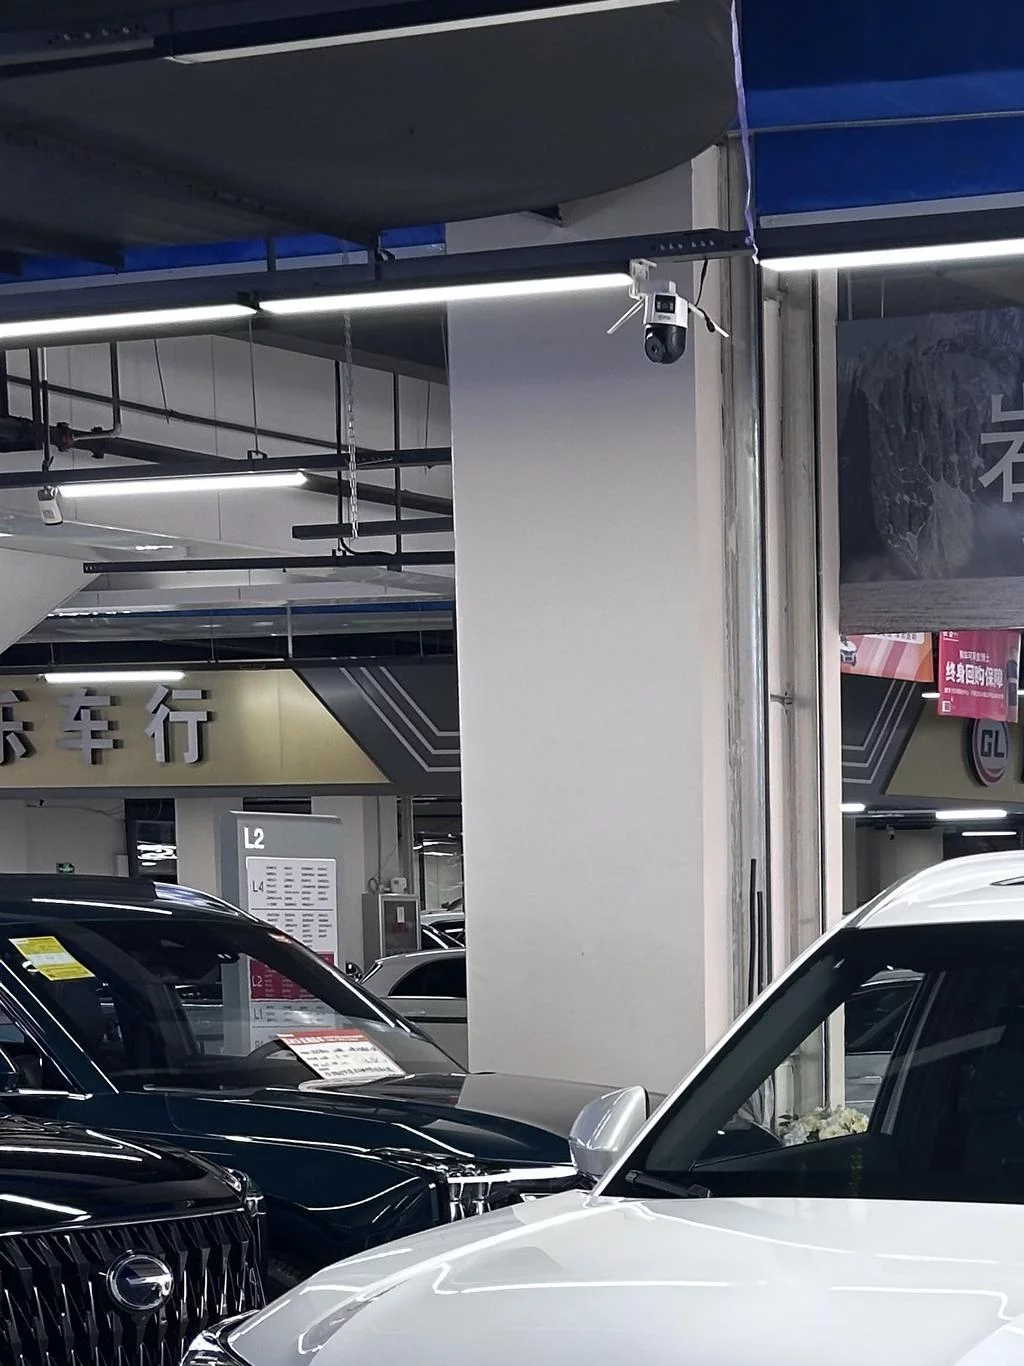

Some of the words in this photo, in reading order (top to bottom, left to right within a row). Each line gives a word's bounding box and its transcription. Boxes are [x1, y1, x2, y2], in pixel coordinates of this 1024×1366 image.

[945, 660, 1004, 689] 终身回购保障
[981, 729, 1005, 758] GL
[243, 826, 265, 850] L2
[252, 880, 264, 893] L4
[251, 975, 263, 987] L2
[253, 1007, 263, 1020] L1
